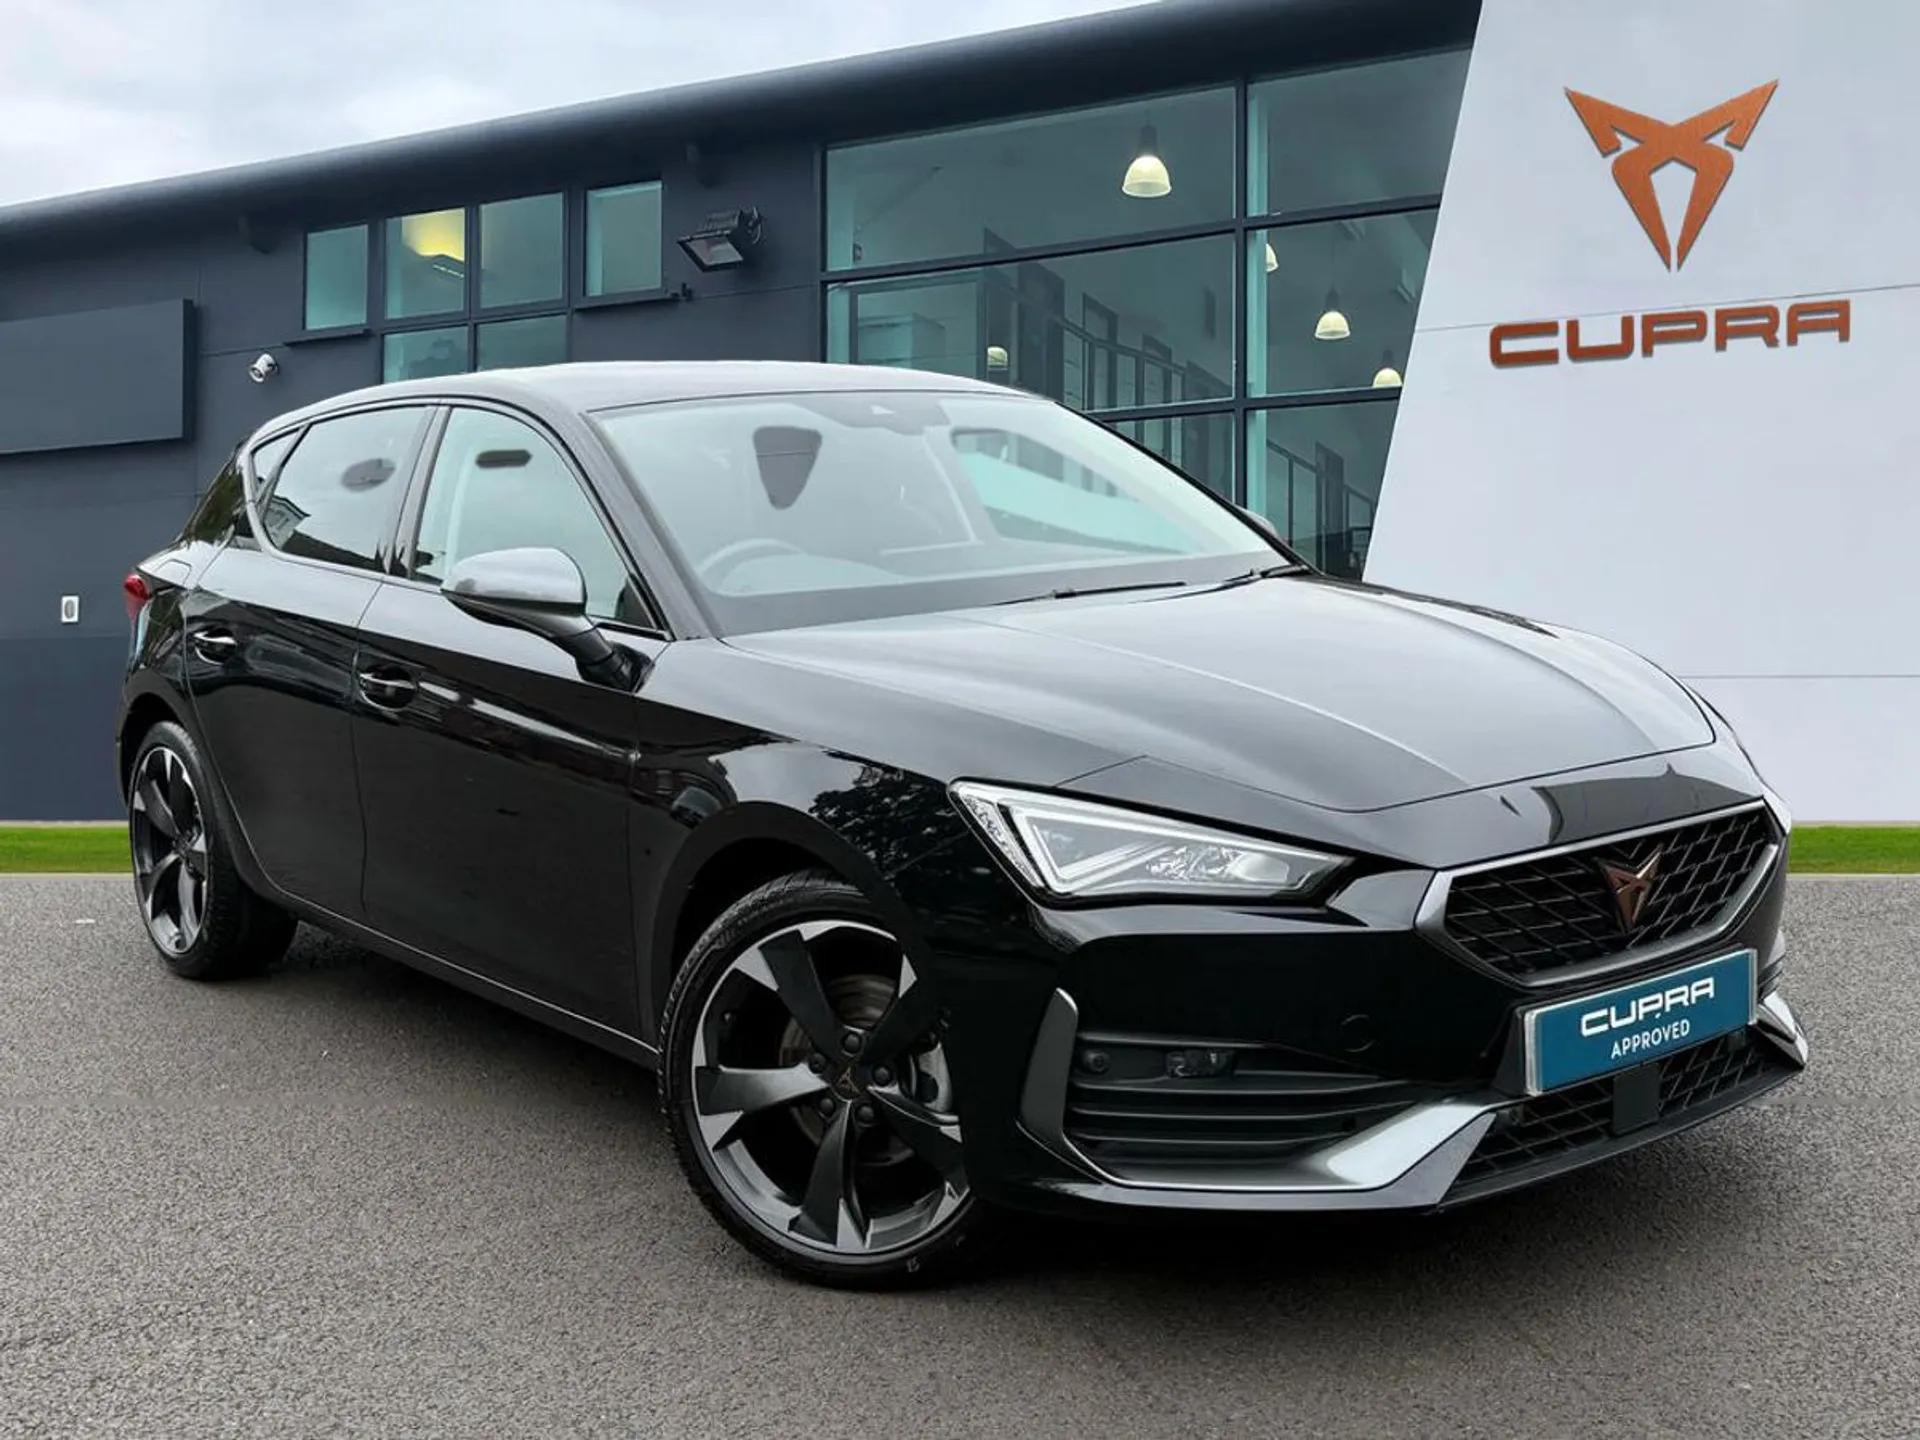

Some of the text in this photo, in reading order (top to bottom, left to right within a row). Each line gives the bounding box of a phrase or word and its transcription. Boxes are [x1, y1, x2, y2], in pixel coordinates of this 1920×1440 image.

[1489, 299, 1850, 369] CUPRA
[1581, 977, 1714, 1037] CUPRA
[1611, 1019, 1690, 1059] APPROVED
